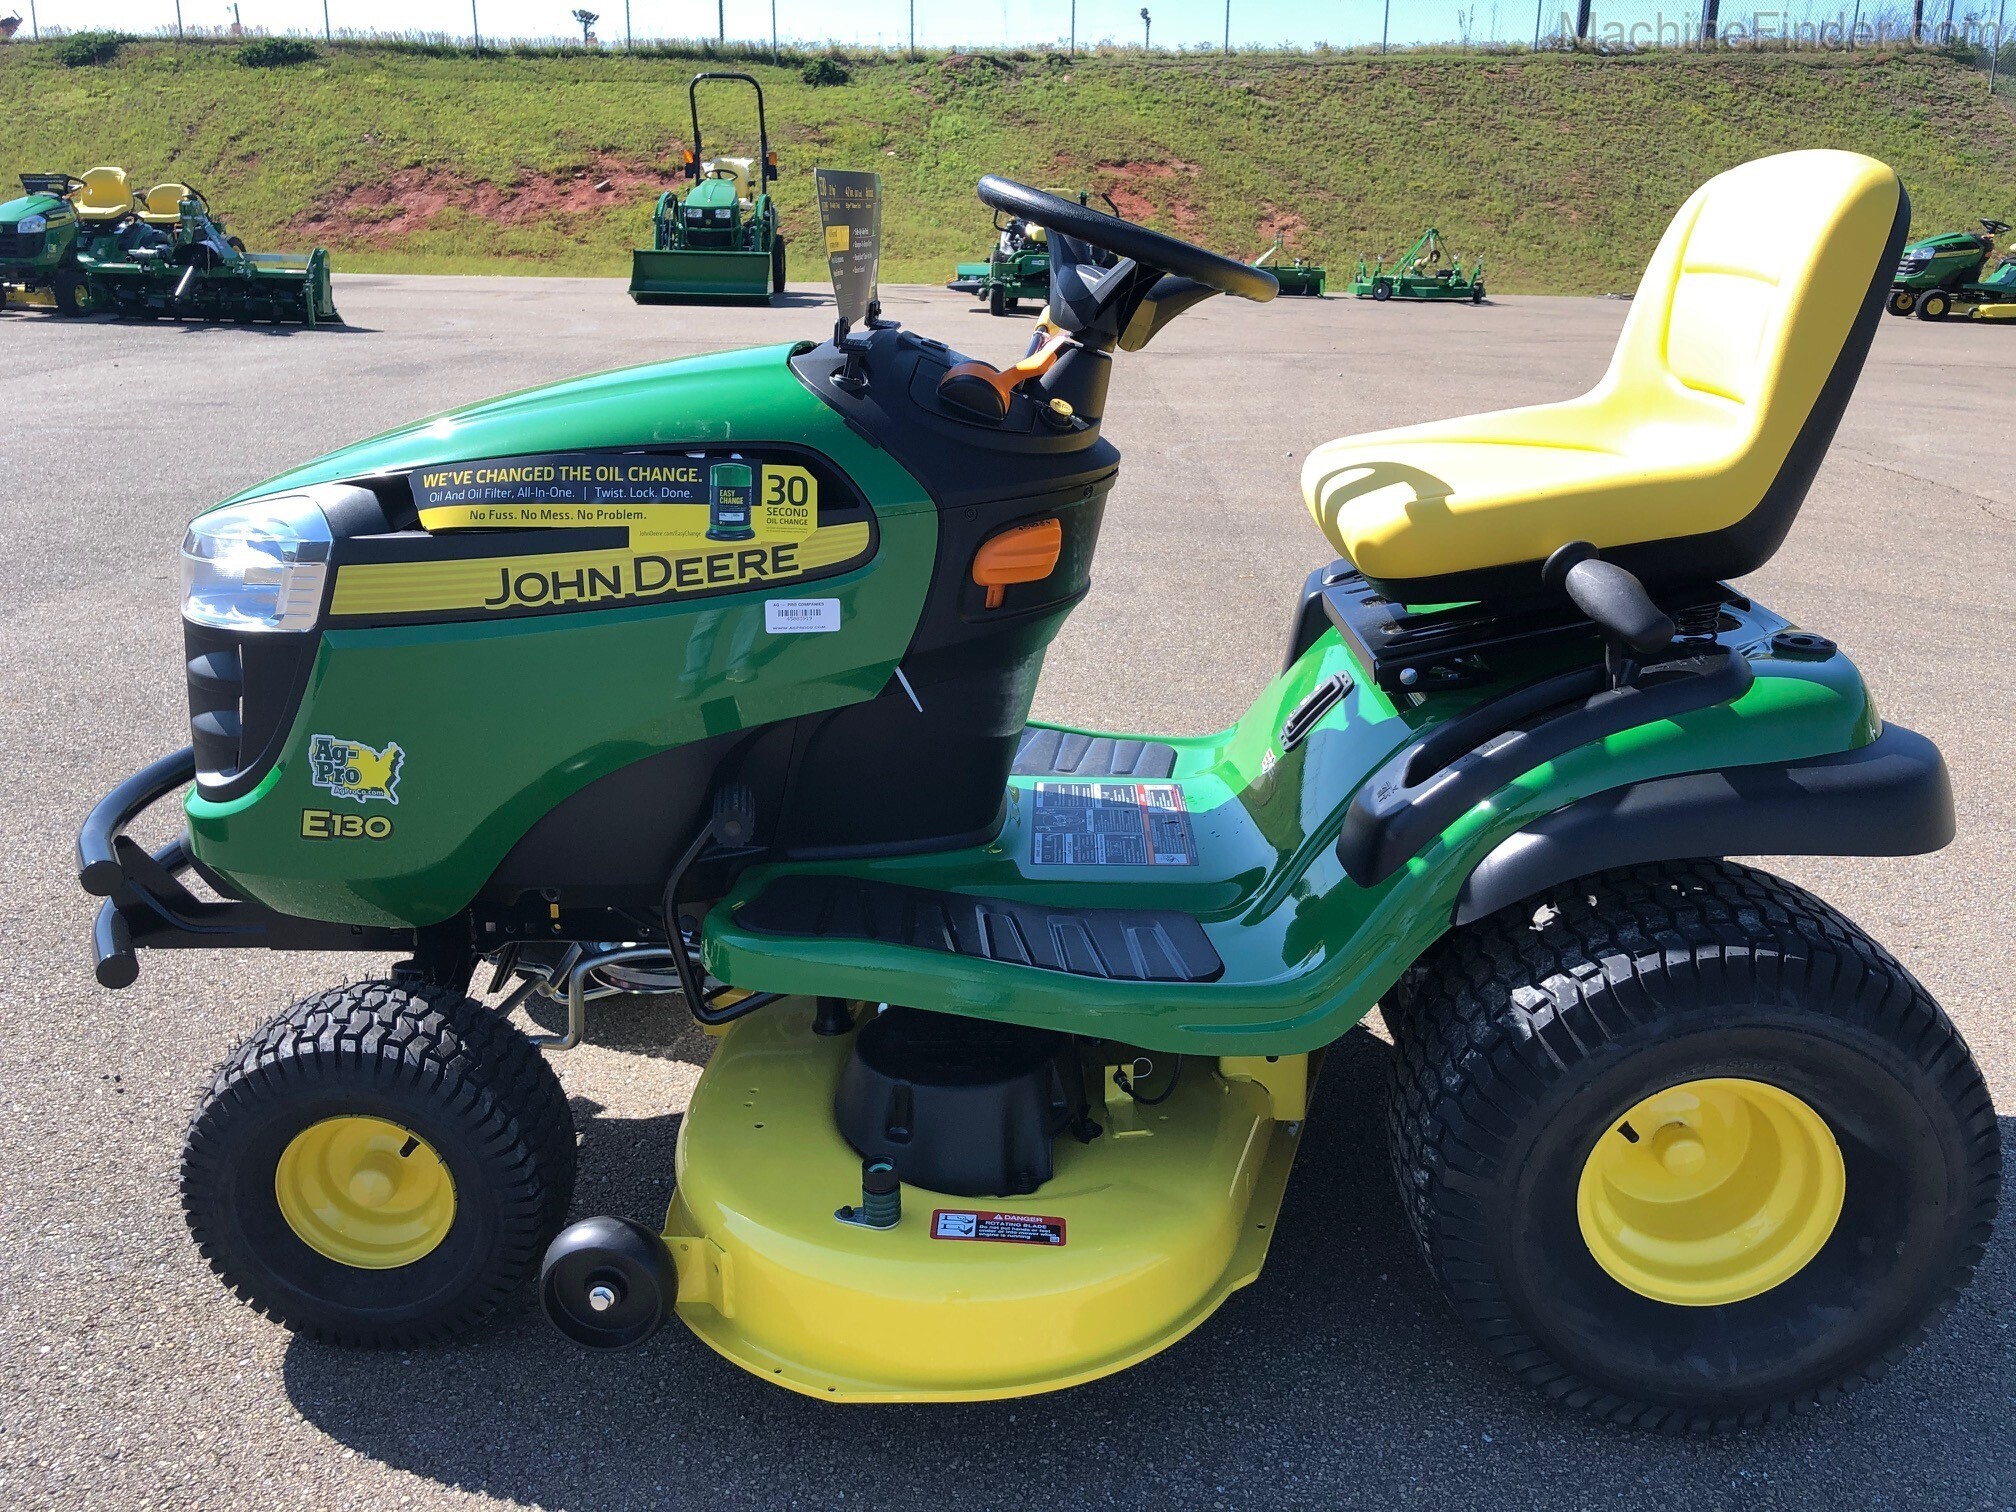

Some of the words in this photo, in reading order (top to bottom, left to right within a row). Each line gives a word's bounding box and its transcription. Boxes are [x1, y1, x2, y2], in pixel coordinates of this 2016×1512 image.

[423, 470, 473, 488] WE'VE
[476, 466, 554, 483] CHANGED
[559, 466, 592, 481] THE
[595, 466, 623, 482] OIL
[628, 466, 703, 482] CHANGE.
[429, 491, 443, 502] Oil
[444, 489, 465, 501] And
[467, 488, 482, 499] Oil
[485, 487, 514, 499] Filter,
[517, 486, 575, 498] All-In-One.
[595, 487, 627, 498] Twist.
[630, 487, 658, 498] Lock.
[661, 487, 693, 498] Done.
[719, 489, 736, 497] EASY
[766, 474, 808, 506] 30
[719, 497, 744, 505] CHANGE
[469, 509, 486, 520] No
[488, 509, 517, 520] Fuss.
[521, 509, 537, 520] No
[540, 509, 573, 520] Mess.
[577, 509, 593, 520] No
[596, 509, 647, 520] Problem.
[766, 507, 808, 518] SECOND
[766, 517, 778, 525] OIL
[779, 517, 808, 526] CHANGE
[484, 567, 622, 605] JOHN
[633, 543, 799, 592] DEERE
[314, 739, 358, 766] Ag-
[317, 761, 361, 785] Pro
[333, 787, 384, 796] AgProCo.com
[302, 809, 392, 838] E130
